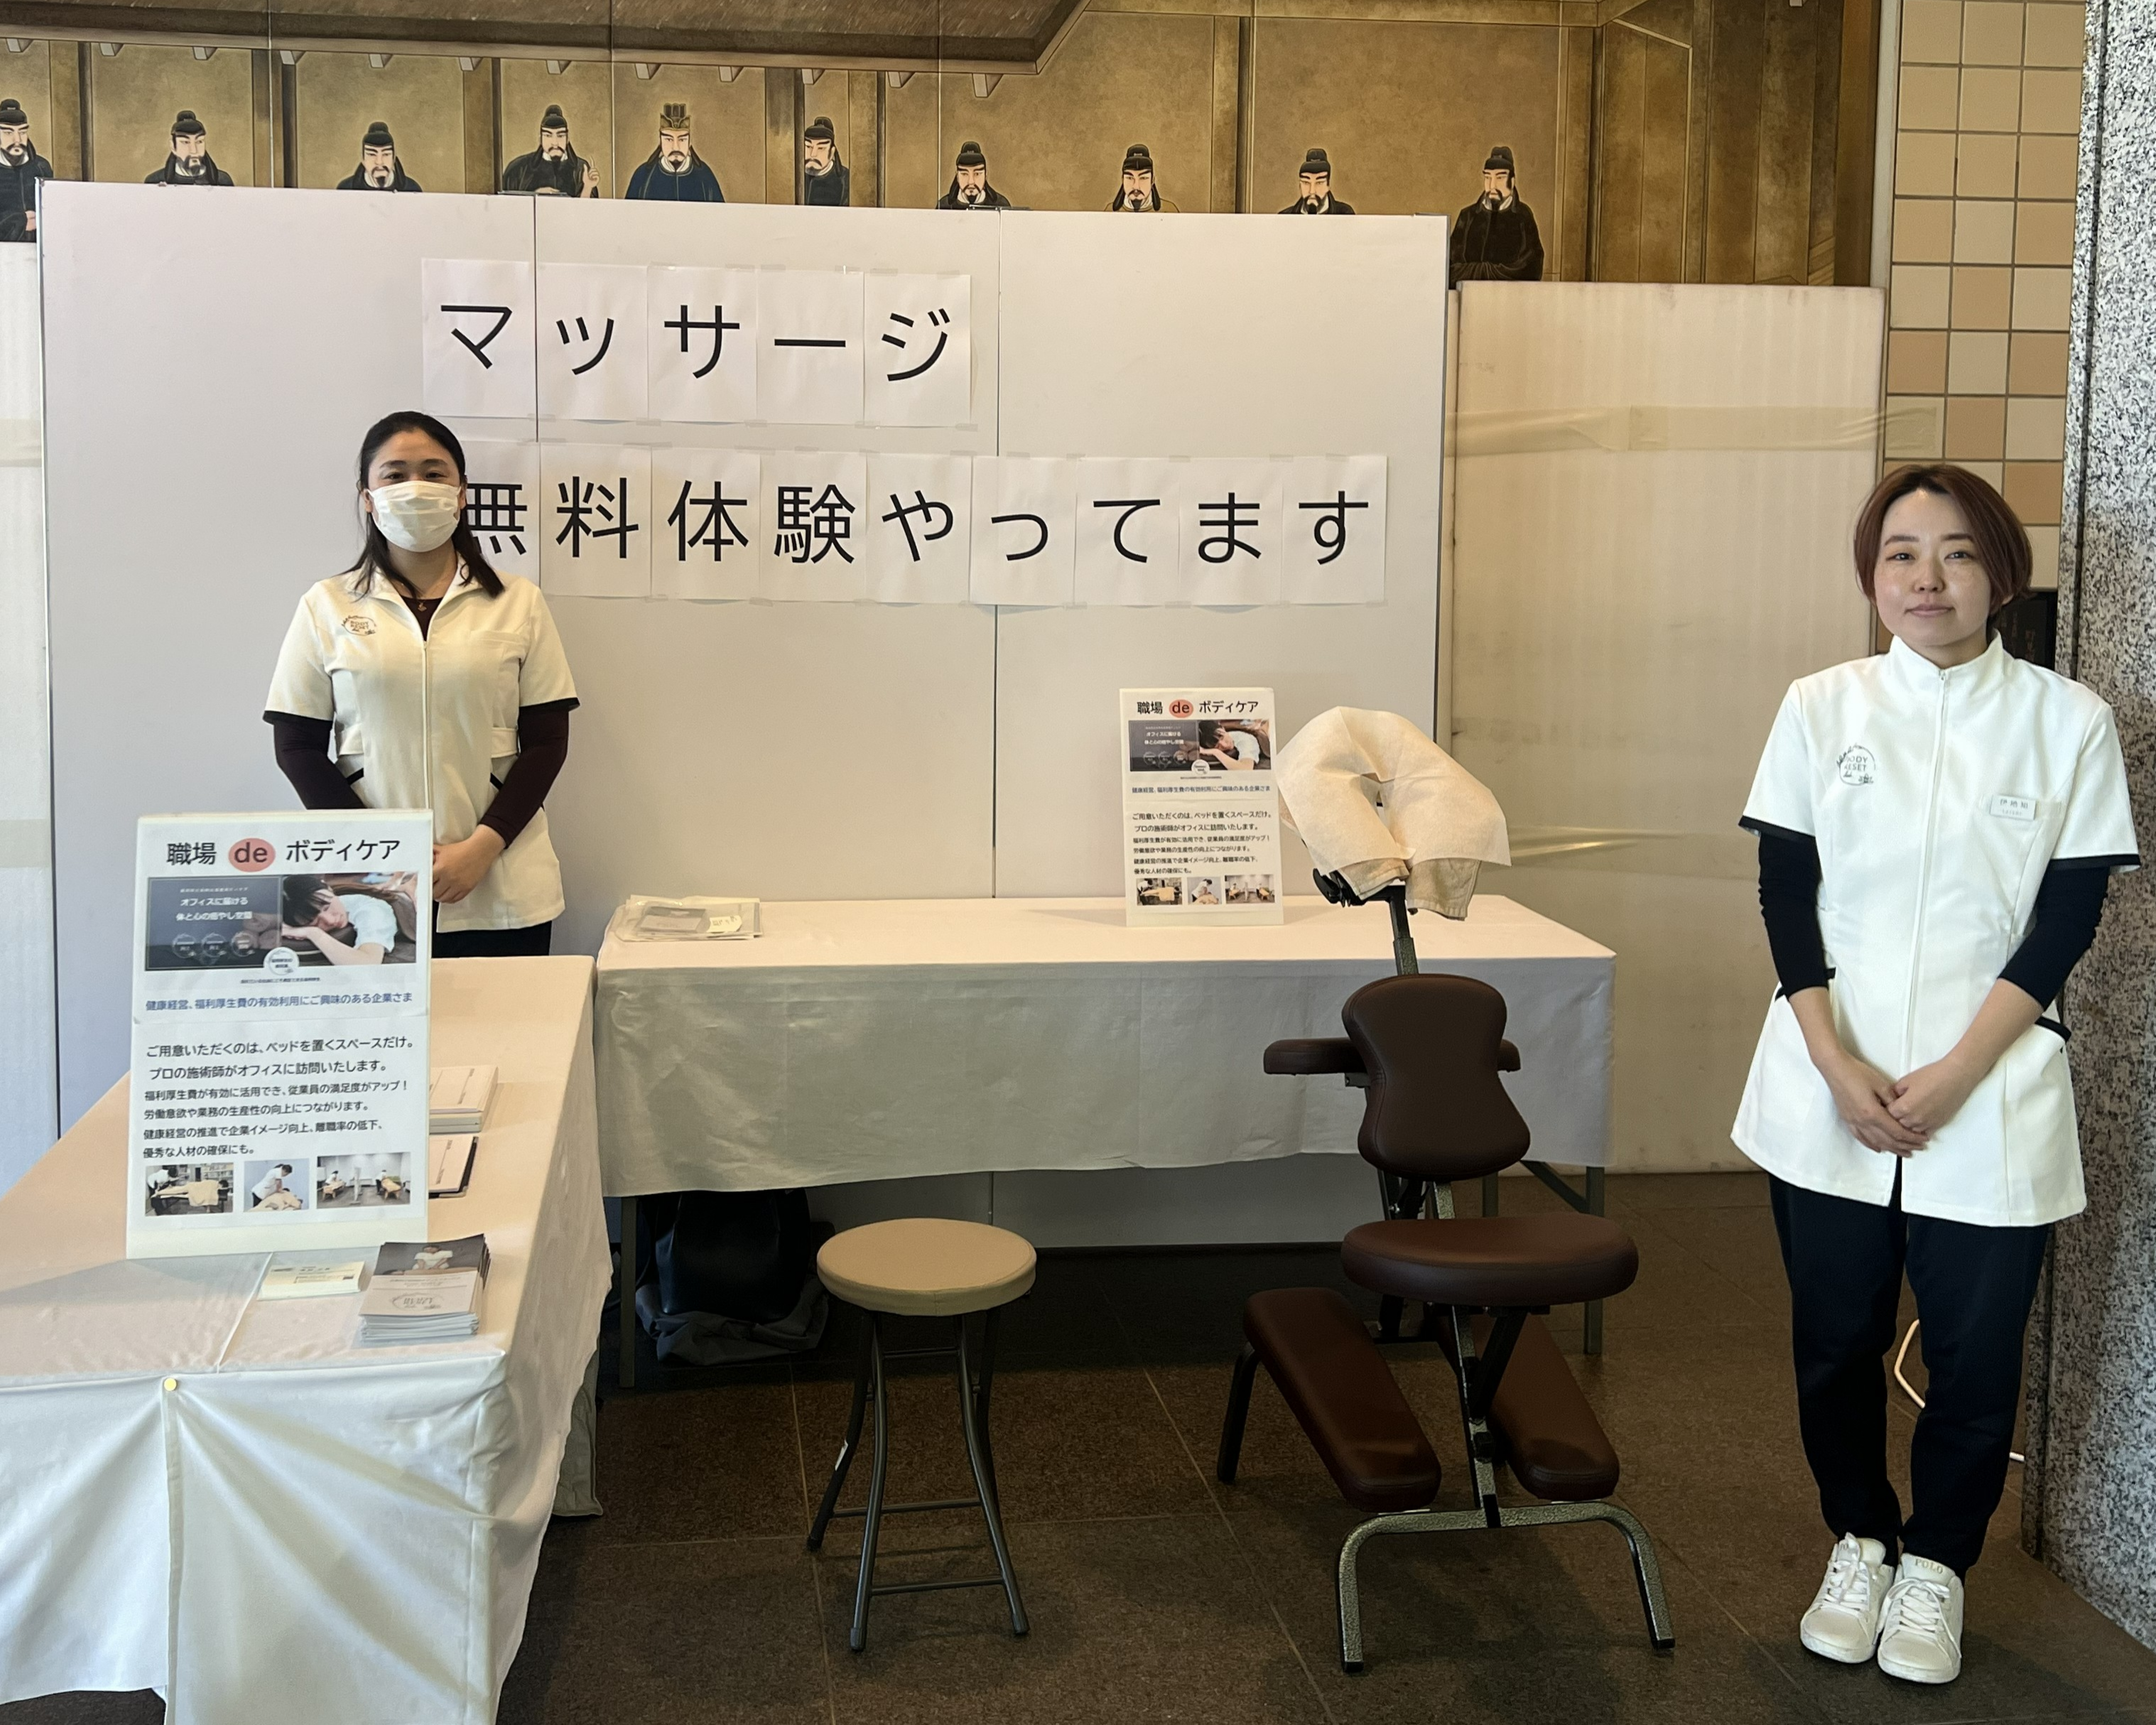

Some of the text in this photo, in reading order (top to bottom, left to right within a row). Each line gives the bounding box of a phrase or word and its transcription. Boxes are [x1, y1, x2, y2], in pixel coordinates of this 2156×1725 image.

[440, 304, 950, 382] マッサージ
[465, 475, 1369, 565] 無料体験やってます
[1137, 701, 1259, 715] 職場 de ボディケア
[166, 839, 401, 866] 職場 de ボディケア
[148, 1060, 388, 1081] プロの施術師がオフィスに訪問いたします。
[1914, 1558, 1944, 1575] POLO
